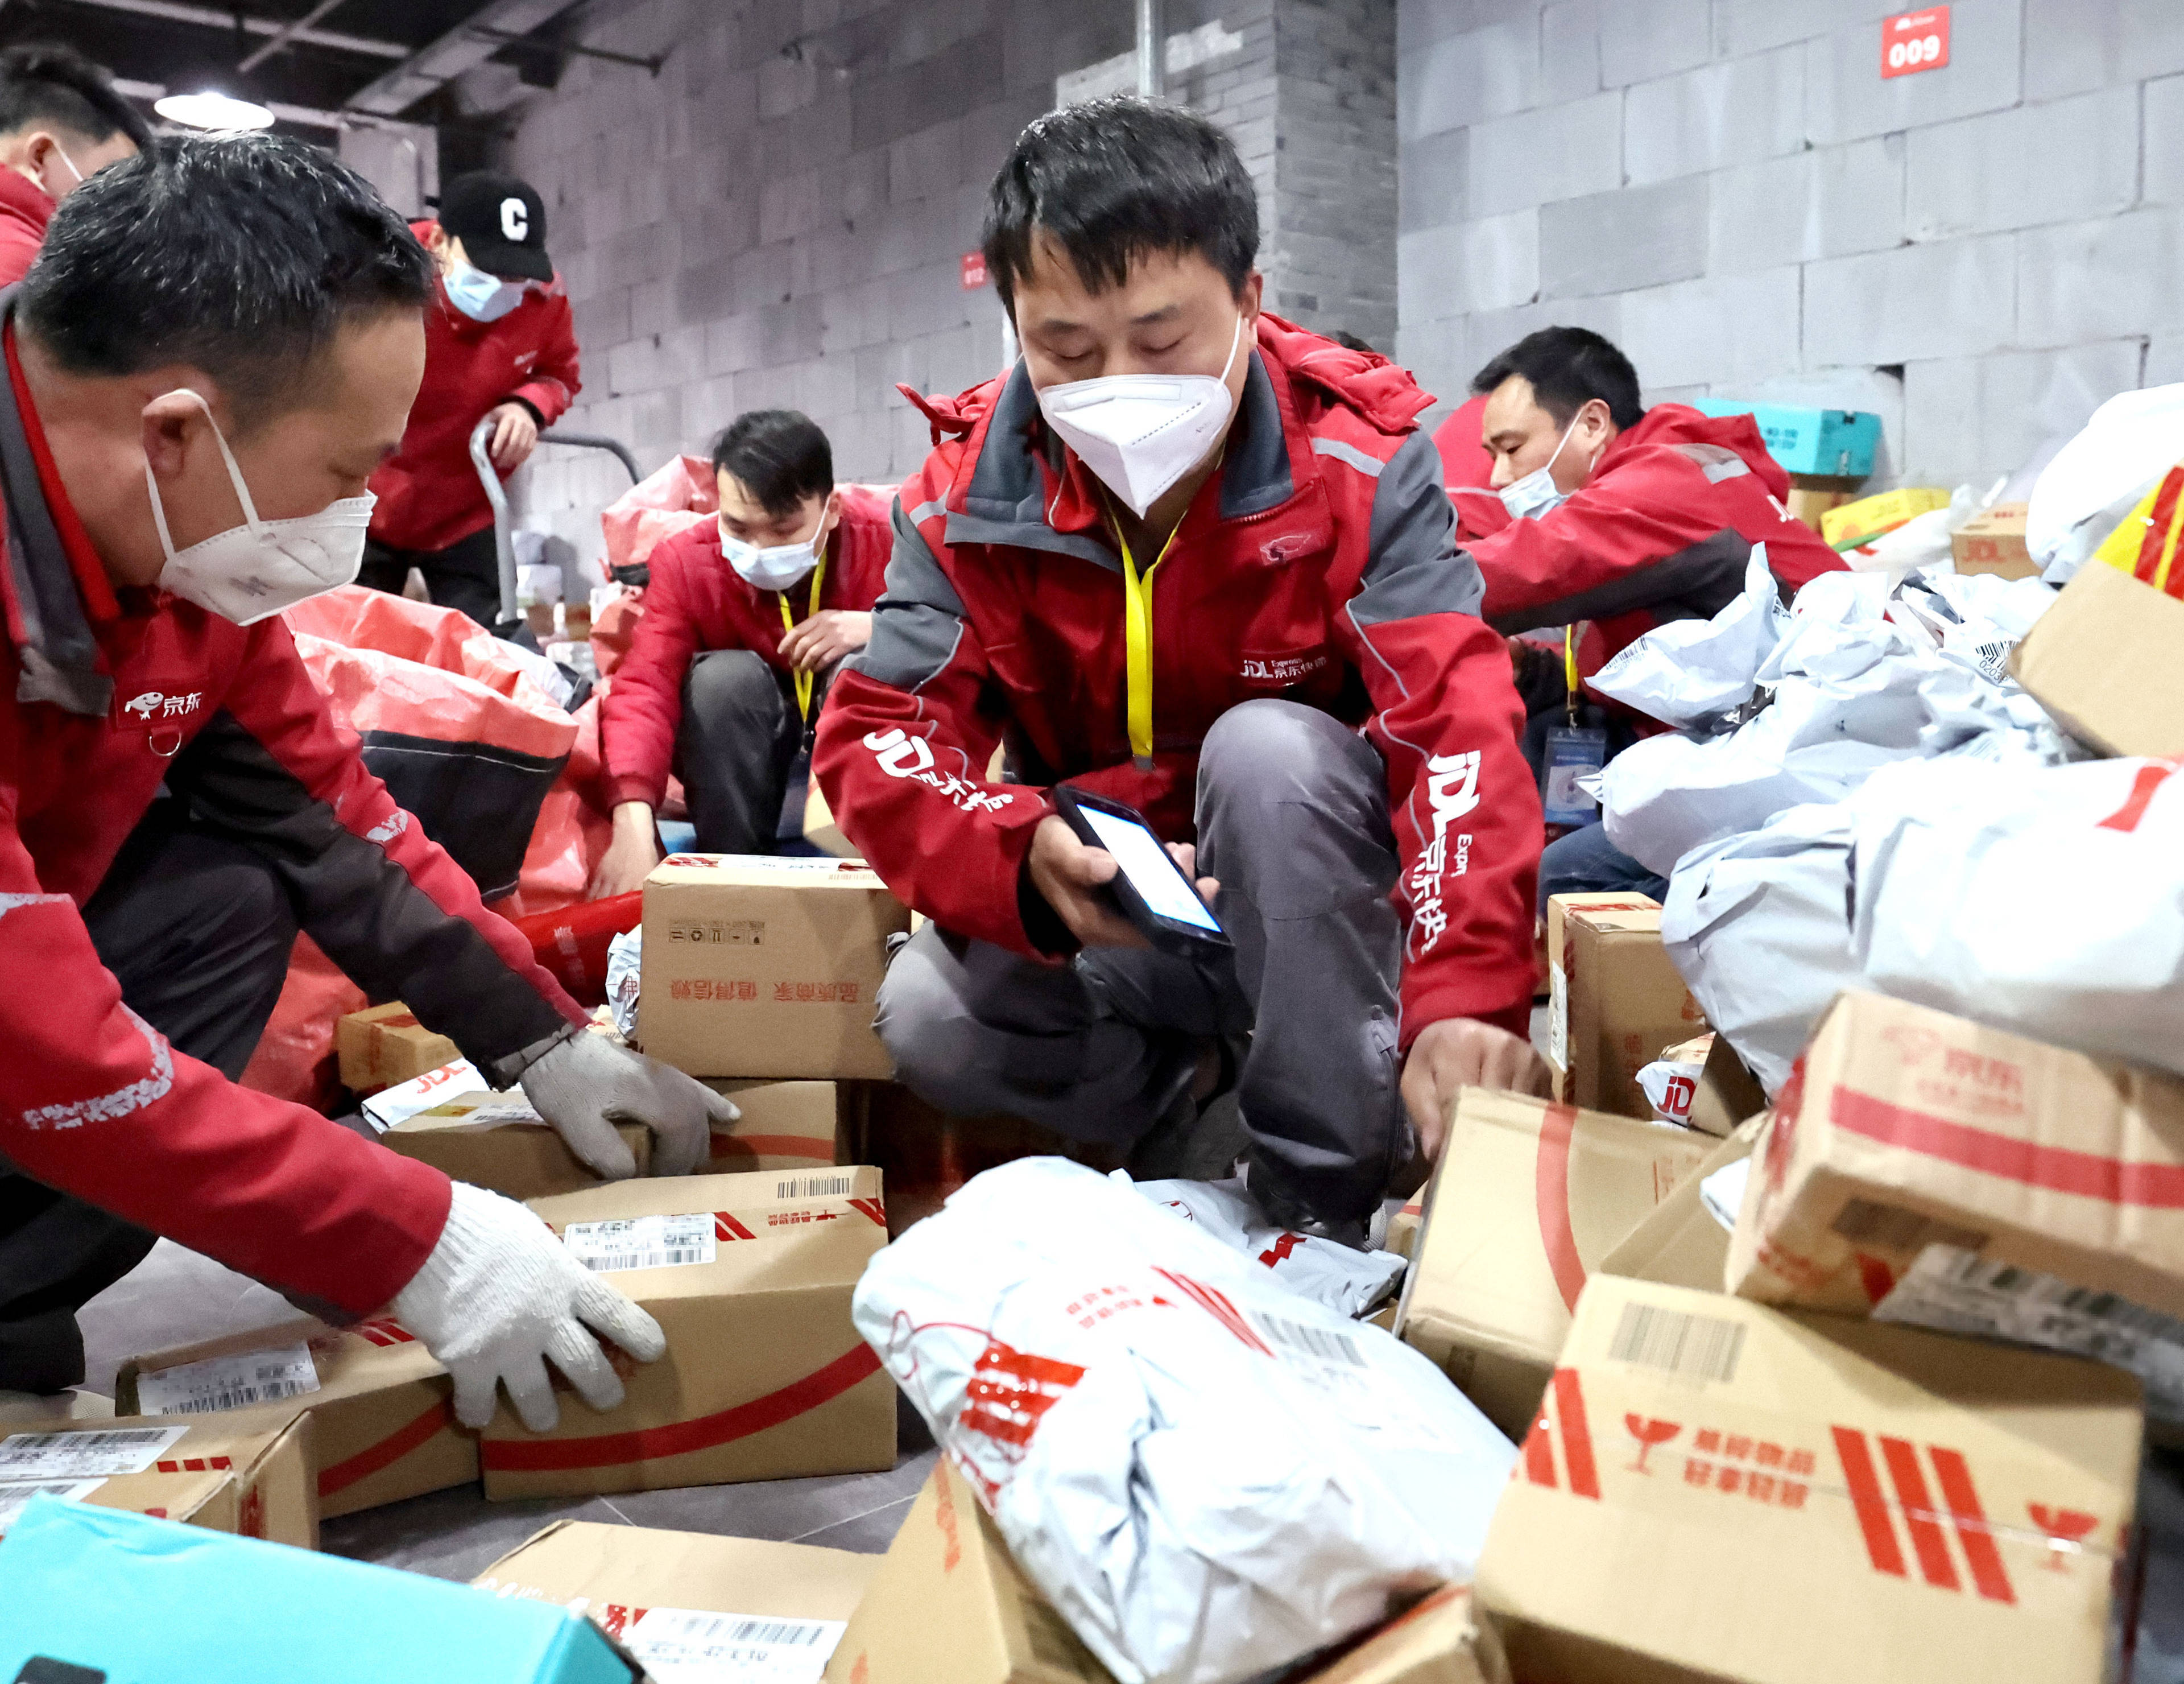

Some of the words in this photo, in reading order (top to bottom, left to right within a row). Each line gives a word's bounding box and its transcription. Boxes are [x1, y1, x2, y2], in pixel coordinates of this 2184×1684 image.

[1889, 35, 1940, 68] 009
[500, 197, 528, 241] C
[1240, 659, 1273, 679] JDL
[163, 692, 202, 718] 京东
[863, 728, 934, 778] JD
[1428, 750, 1482, 841] JDL
[1410, 835, 1448, 956] 京东快
[774, 981, 860, 1002] 品质商家
